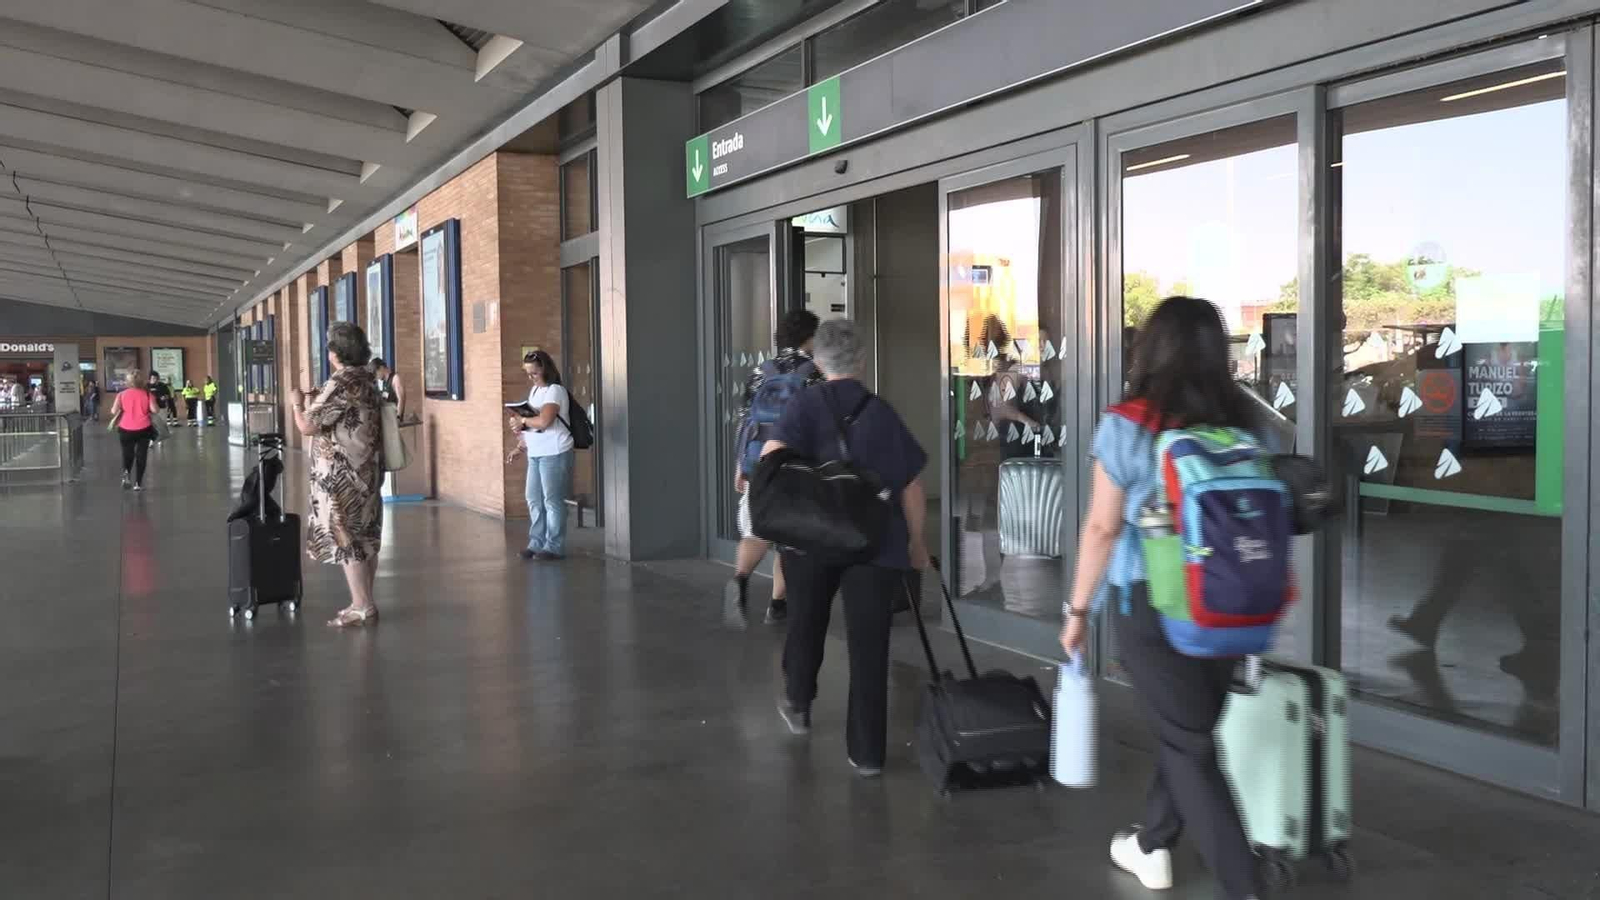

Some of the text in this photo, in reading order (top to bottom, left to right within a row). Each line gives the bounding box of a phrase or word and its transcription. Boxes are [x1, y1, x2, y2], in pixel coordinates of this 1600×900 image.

[712, 132, 743, 159] Entrada
[0, 343, 54, 352] Donald's
[1469, 366, 1520, 379] MANUEL
